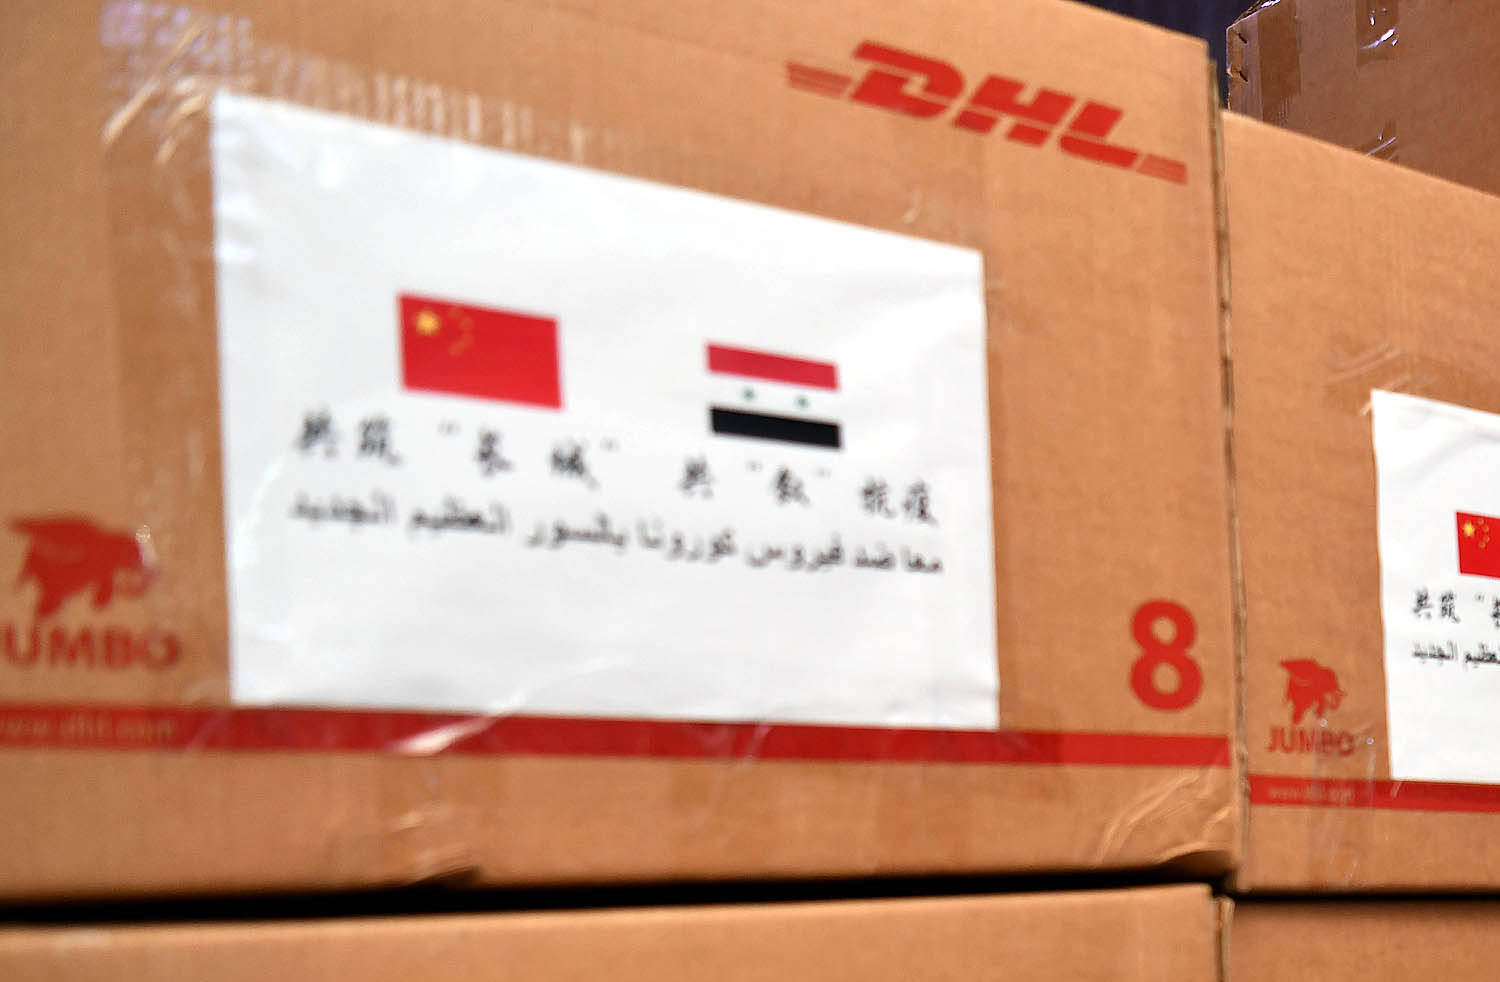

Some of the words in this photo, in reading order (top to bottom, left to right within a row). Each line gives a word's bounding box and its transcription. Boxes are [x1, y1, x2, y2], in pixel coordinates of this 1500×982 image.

[850, 40, 1142, 170] DHL
[2, 622, 181, 671] UMBO
[1130, 600, 1199, 711] 8
[1267, 727, 1354, 757] JUMBO
